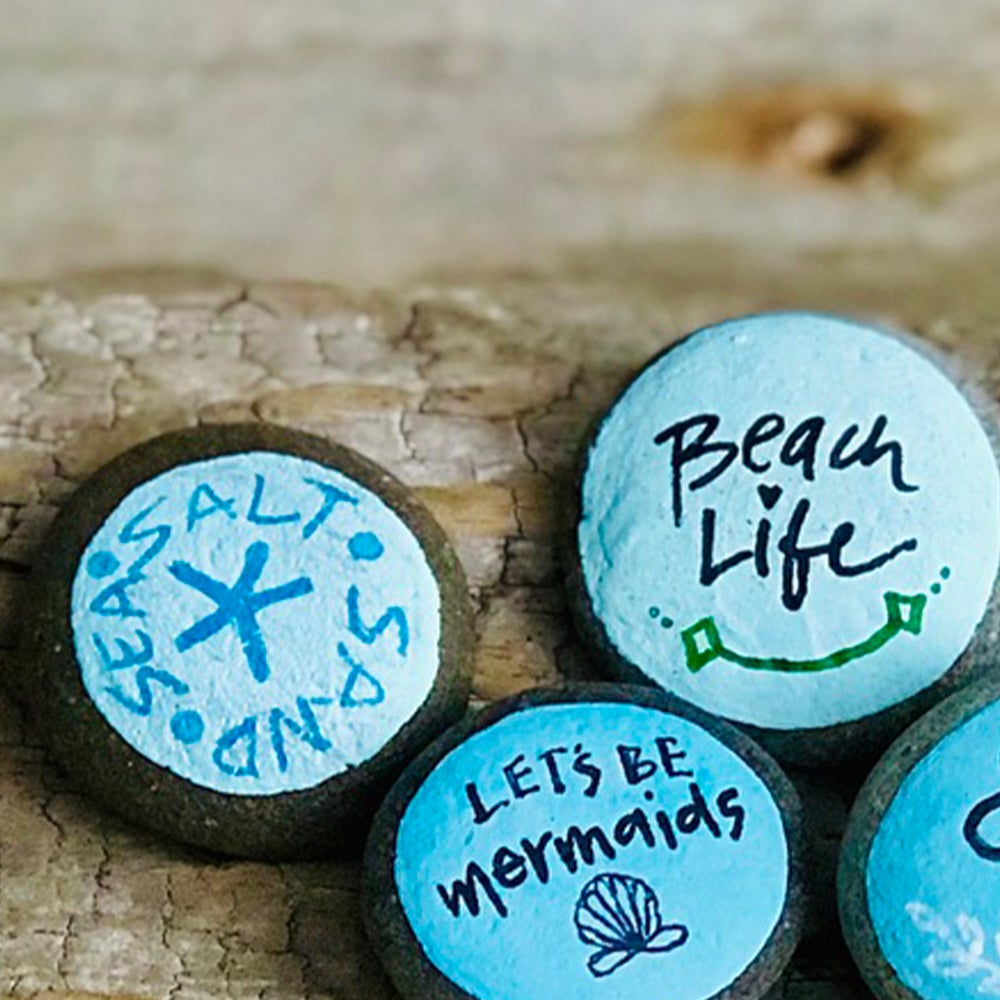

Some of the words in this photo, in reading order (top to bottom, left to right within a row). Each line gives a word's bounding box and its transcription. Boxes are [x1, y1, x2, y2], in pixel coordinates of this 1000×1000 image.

[118, 473, 359, 574] SALT
[655, 412, 919, 527] Beach
[699, 484, 917, 611] Life
[90, 571, 190, 717] SEA
[213, 584, 409, 779] SAND
[465, 743, 602, 824] LET'S
[617, 737, 695, 785] BE
[437, 783, 745, 918] mermaids
